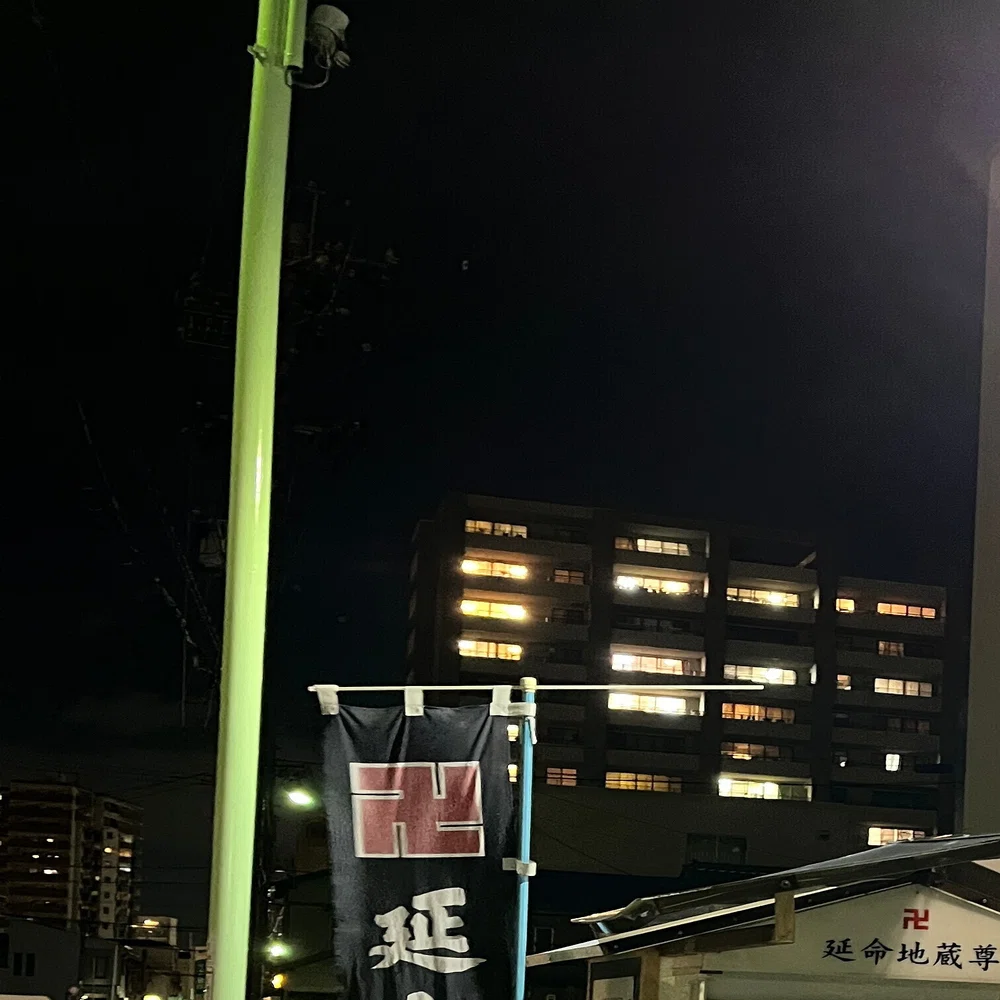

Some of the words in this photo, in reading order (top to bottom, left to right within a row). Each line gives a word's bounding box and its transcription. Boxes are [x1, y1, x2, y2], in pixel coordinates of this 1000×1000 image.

[823, 937, 1000, 971] 延命地蔵尊
